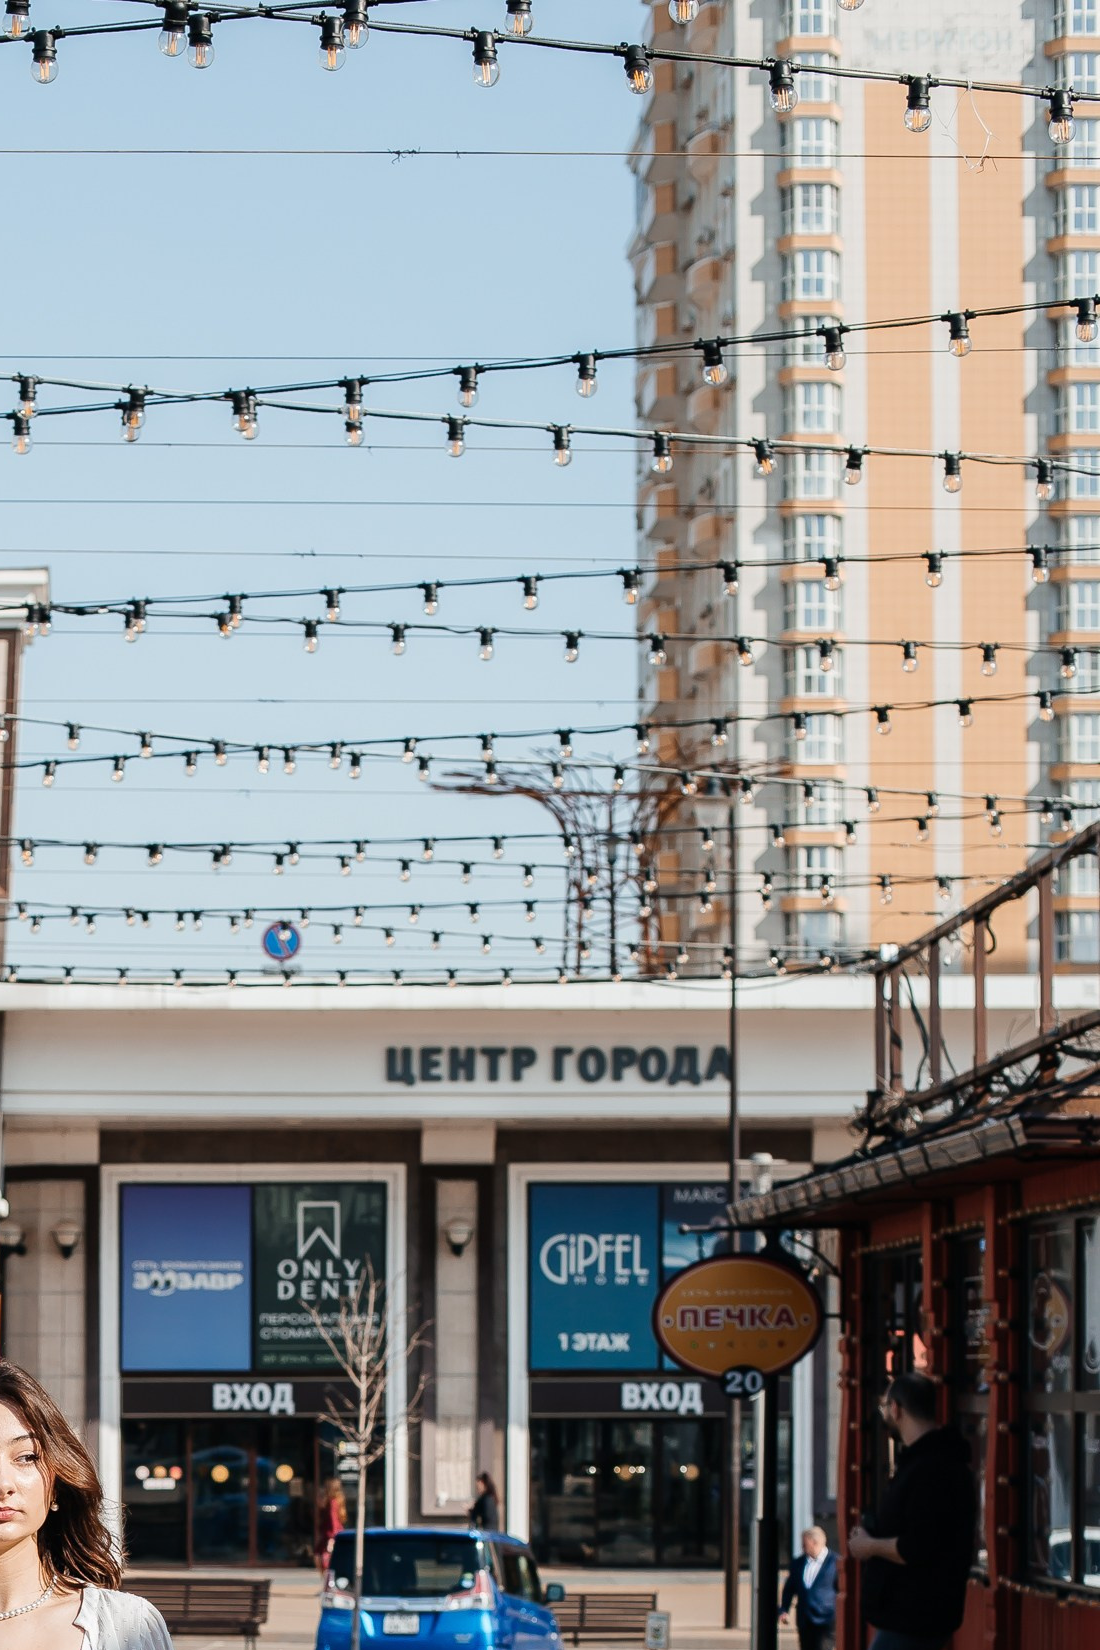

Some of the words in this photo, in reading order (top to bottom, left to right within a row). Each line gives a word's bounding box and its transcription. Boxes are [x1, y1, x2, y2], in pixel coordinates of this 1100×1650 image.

[385, 1046, 538, 1086] ЦЕНТР
[552, 1046, 733, 1086] ГОРОДА
[276, 1259, 361, 1280] ONLY
[277, 1280, 359, 1301] DENT
[678, 1305, 797, 1330] ПЕЧКА
[558, 1333, 568, 1351] 1
[571, 1333, 631, 1352] ЭТАЖ
[724, 1370, 764, 1394] 20
[212, 1383, 295, 1415] ВХОД
[621, 1382, 704, 1415] ВХОД
